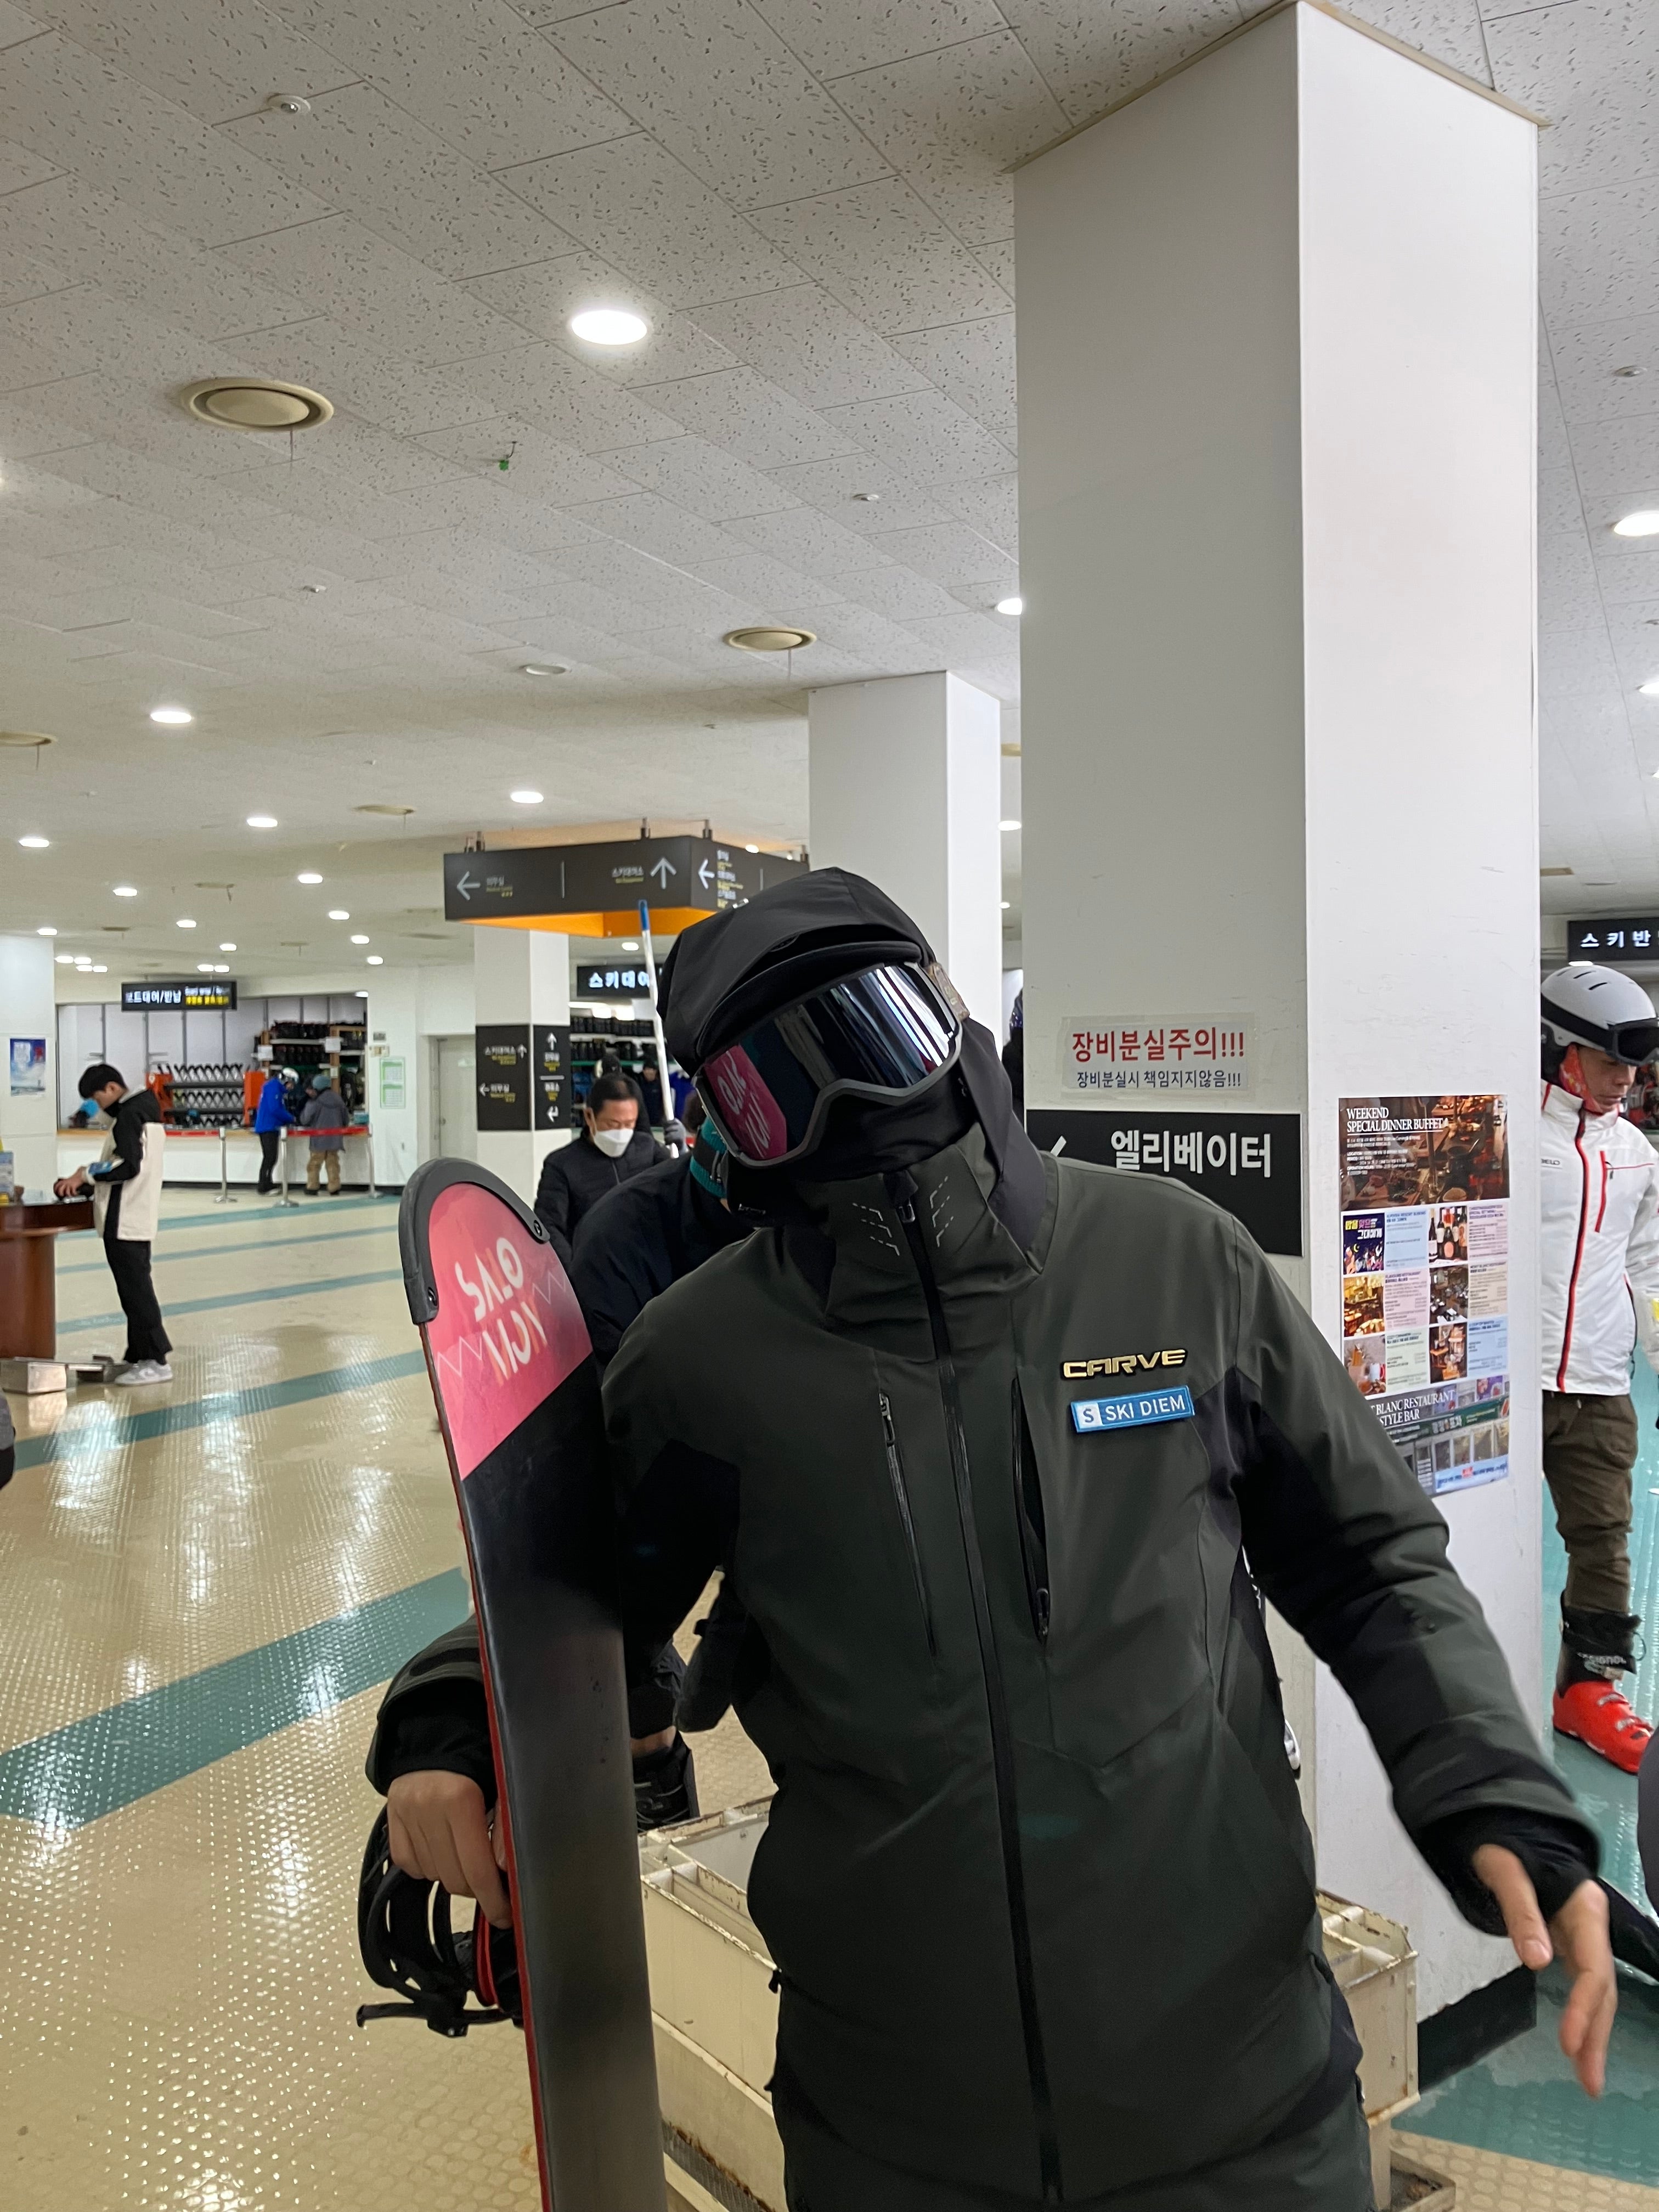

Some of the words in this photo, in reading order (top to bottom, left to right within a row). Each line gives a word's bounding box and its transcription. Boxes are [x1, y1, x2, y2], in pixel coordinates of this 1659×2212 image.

[1579, 929, 1659, 949] 스키반
[1072, 1026, 1245, 1063] 장비분실주의!!!
[1077, 1071, 1139, 1088] 장비분실시
[1143, 1070, 1241, 1088] 책임지지않음!!!
[1346, 1107, 1389, 1120] WEEKEND
[1347, 1120, 1381, 1133] SPECIAL
[1381, 1119, 1413, 1131] DINNER
[1414, 1118, 1443, 1130] BUFFET
[1110, 1130, 1271, 1178] 엘리베이터
[1063, 1348, 1186, 1379] CARVE
[1083, 1408, 1094, 1423] S
[1105, 1402, 1134, 1421] SKI
[1139, 1394, 1186, 1417] DIEM
[1376, 1400, 1404, 1416] BLANC
[1404, 1389, 1455, 1410] RESTAURANT
[1379, 1412, 1405, 1426] STYLE
[1405, 1409, 1420, 1422] BAR
